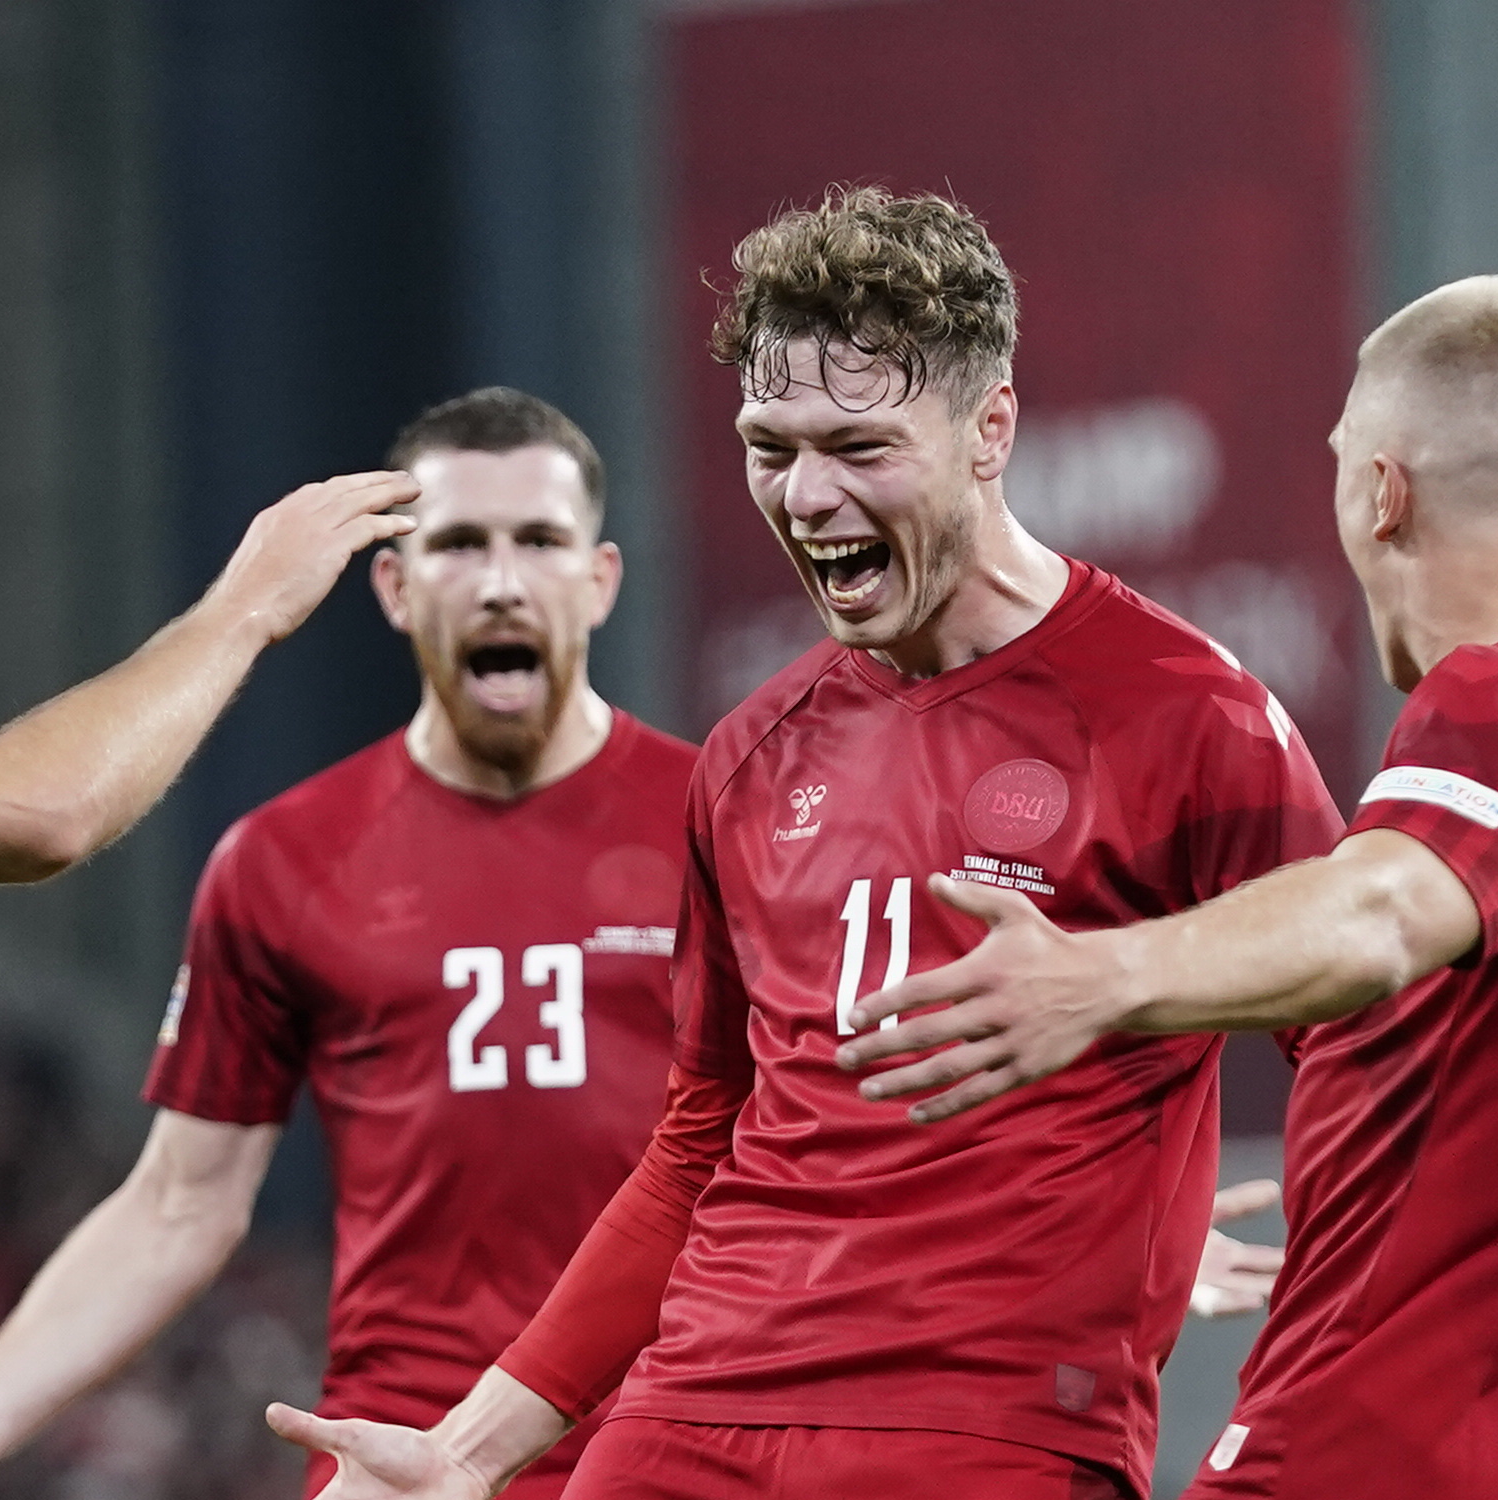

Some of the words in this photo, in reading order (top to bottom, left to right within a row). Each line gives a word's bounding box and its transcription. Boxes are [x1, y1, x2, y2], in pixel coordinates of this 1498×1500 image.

[1011, 862, 1043, 880] FRANCE
[442, 943, 587, 1092] 23
[835, 877, 911, 1036] 11
